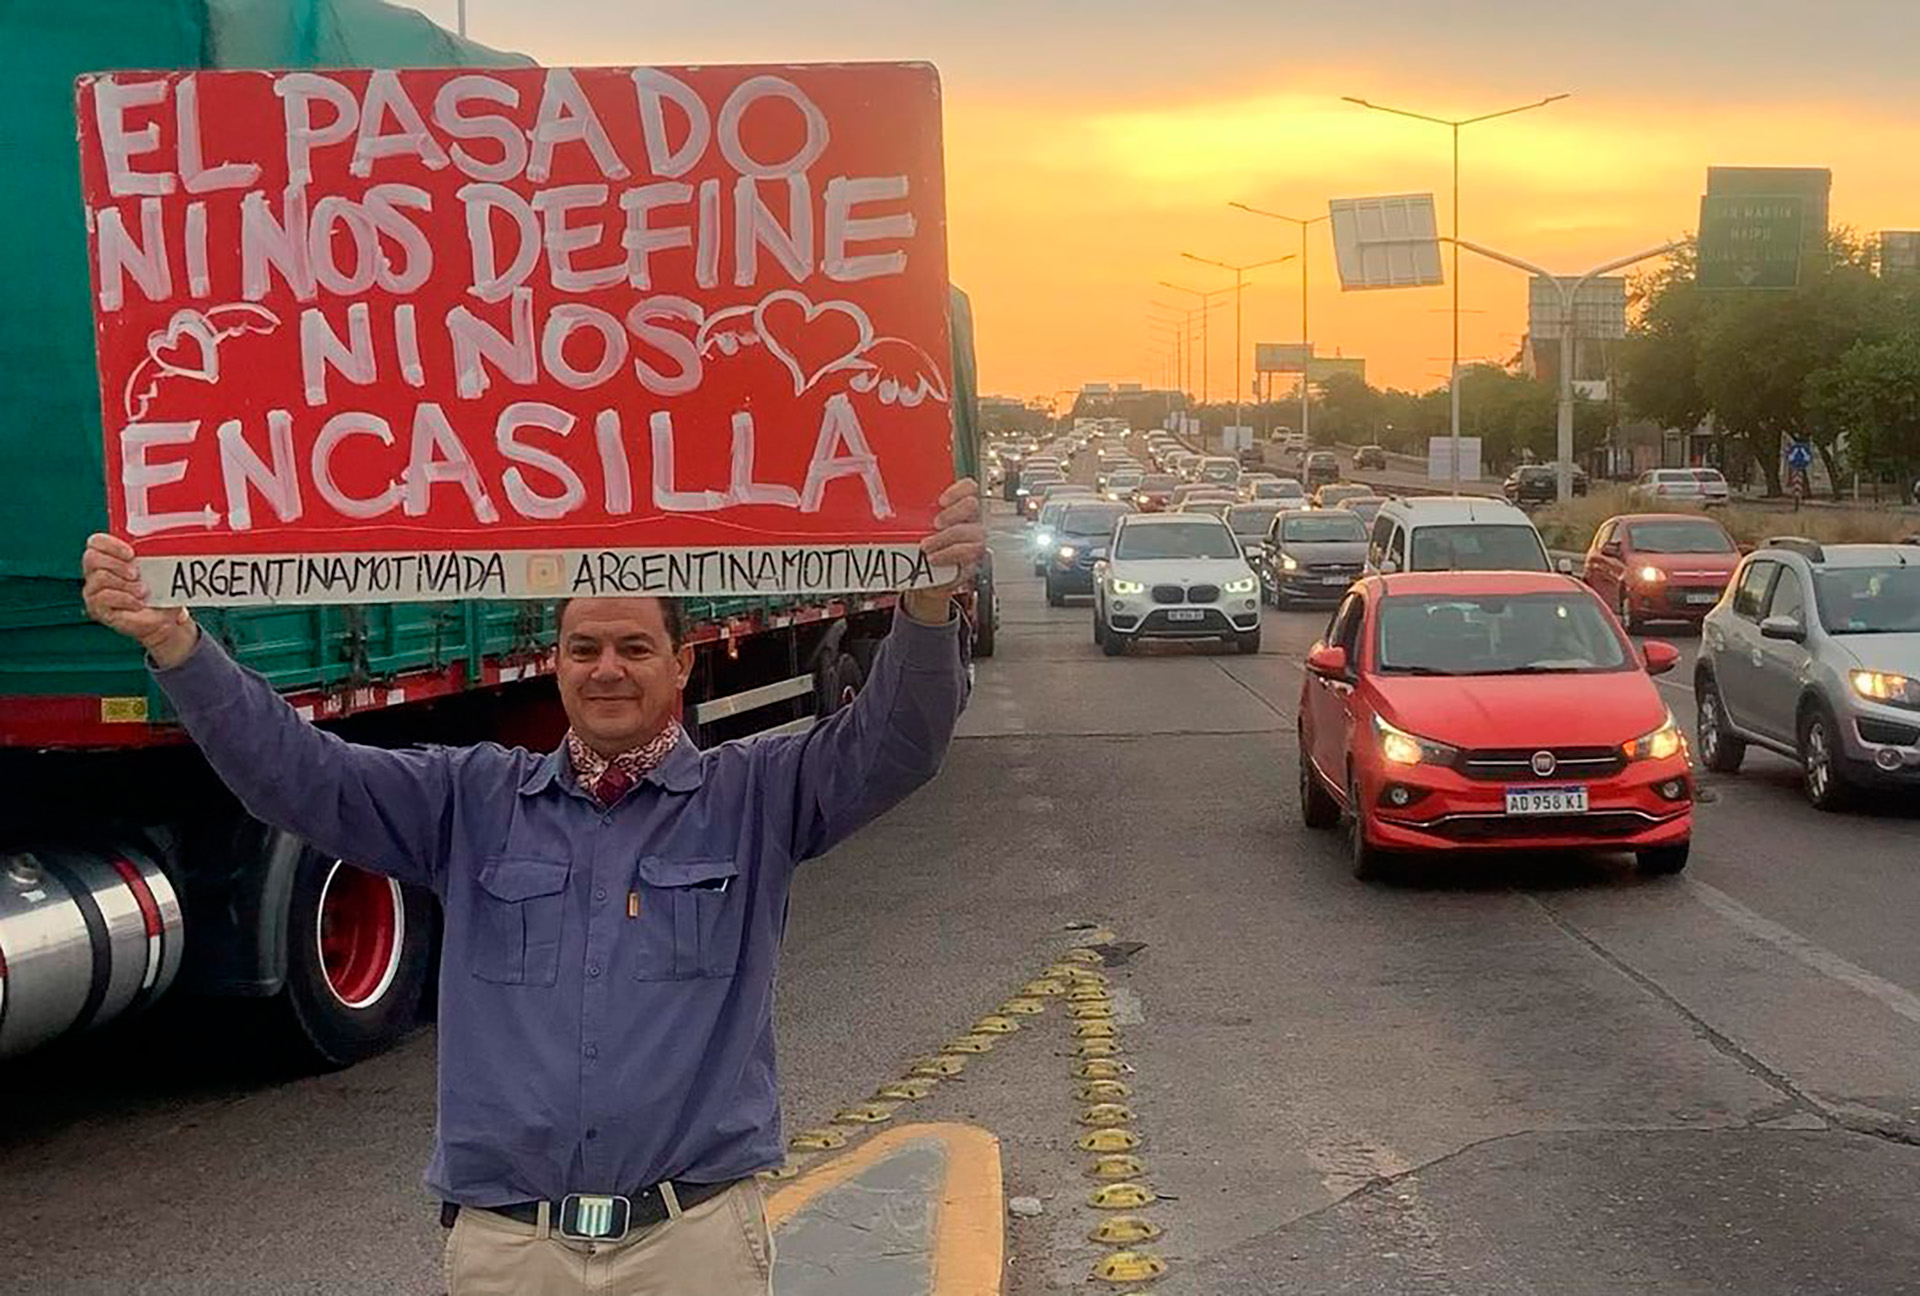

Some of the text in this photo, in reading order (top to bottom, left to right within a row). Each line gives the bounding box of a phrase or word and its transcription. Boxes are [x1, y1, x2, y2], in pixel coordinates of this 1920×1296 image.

[95, 67, 830, 196] EL PASADO
[98, 172, 917, 312] NI NOS DEFINE
[301, 286, 703, 406] NI NOS
[120, 393, 896, 536] ENCASILLA
[170, 550, 935, 599] ARGENTINAMOTIVADA ARGENTINAMOTIVADA
[1533, 795, 1562, 810] 958
